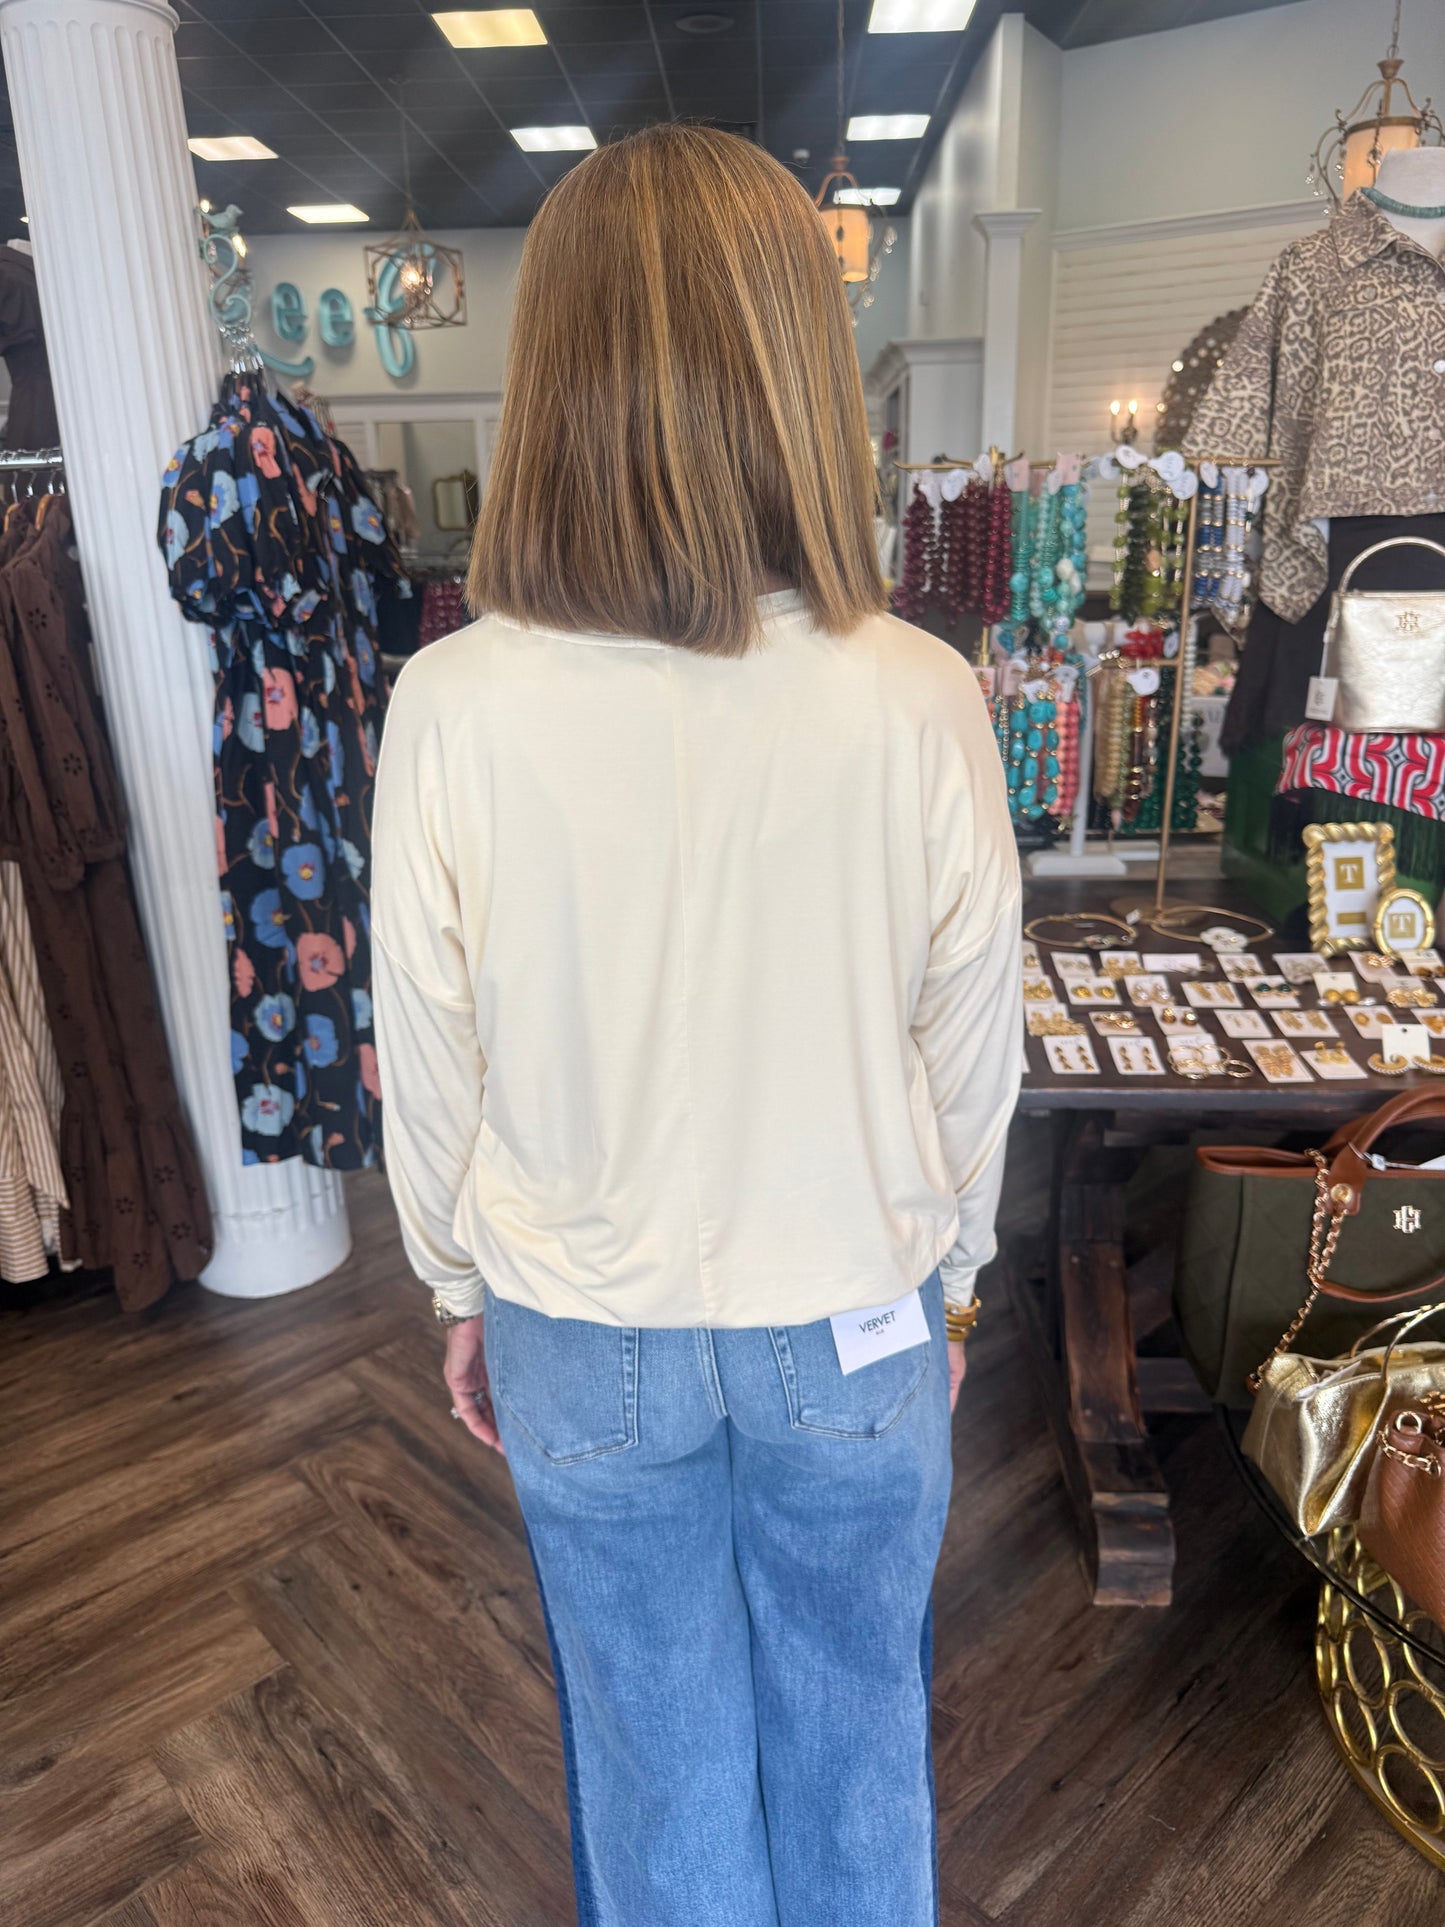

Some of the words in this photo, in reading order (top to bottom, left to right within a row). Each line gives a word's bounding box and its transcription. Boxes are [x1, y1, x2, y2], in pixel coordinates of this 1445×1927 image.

[1340, 864, 1359, 883] T
[1392, 915, 1412, 933] T
[859, 1310, 896, 1333] VERVET
